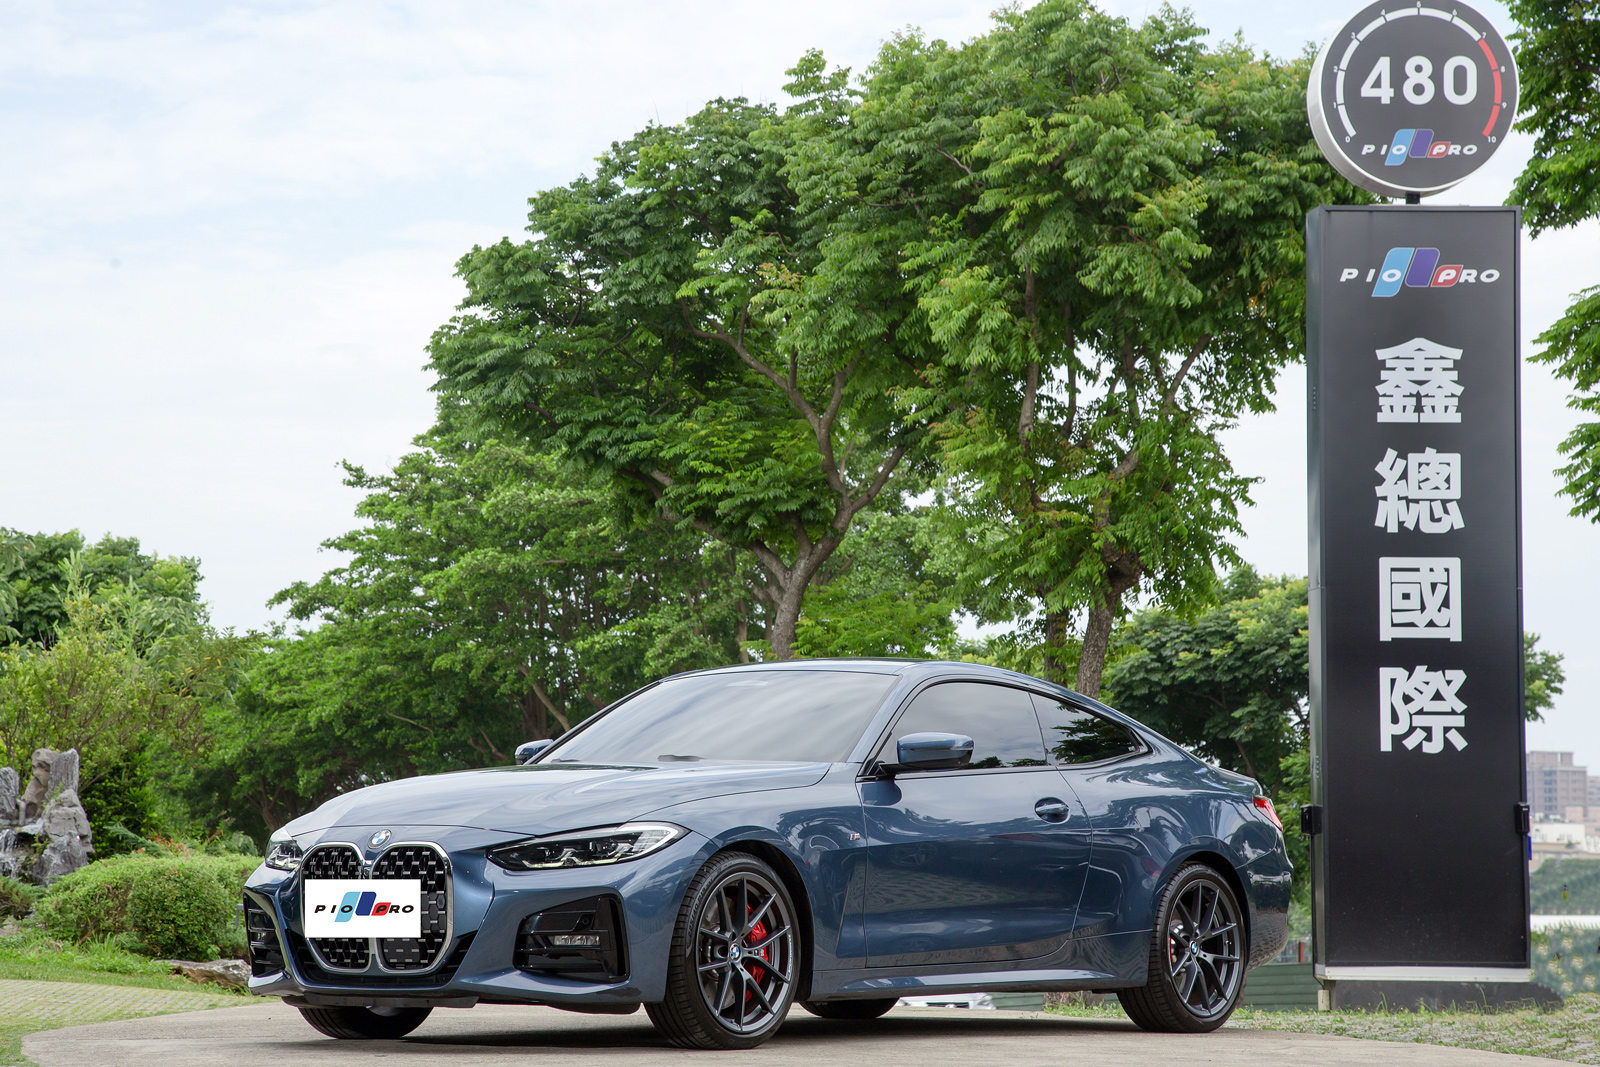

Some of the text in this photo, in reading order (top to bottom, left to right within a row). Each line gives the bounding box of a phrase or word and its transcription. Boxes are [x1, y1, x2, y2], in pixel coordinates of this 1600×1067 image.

[1333, 65, 1338, 73] 2
[1500, 65, 1506, 73] 8
[1360, 55, 1478, 105] 480
[1333, 101, 1337, 109] 1
[1502, 101, 1507, 109] 9
[1487, 135, 1497, 143] 10
[1361, 144, 1478, 156] PIO PRO
[1340, 268, 1500, 283] PIO PRO
[1374, 337, 1468, 754] 鑫總國際
